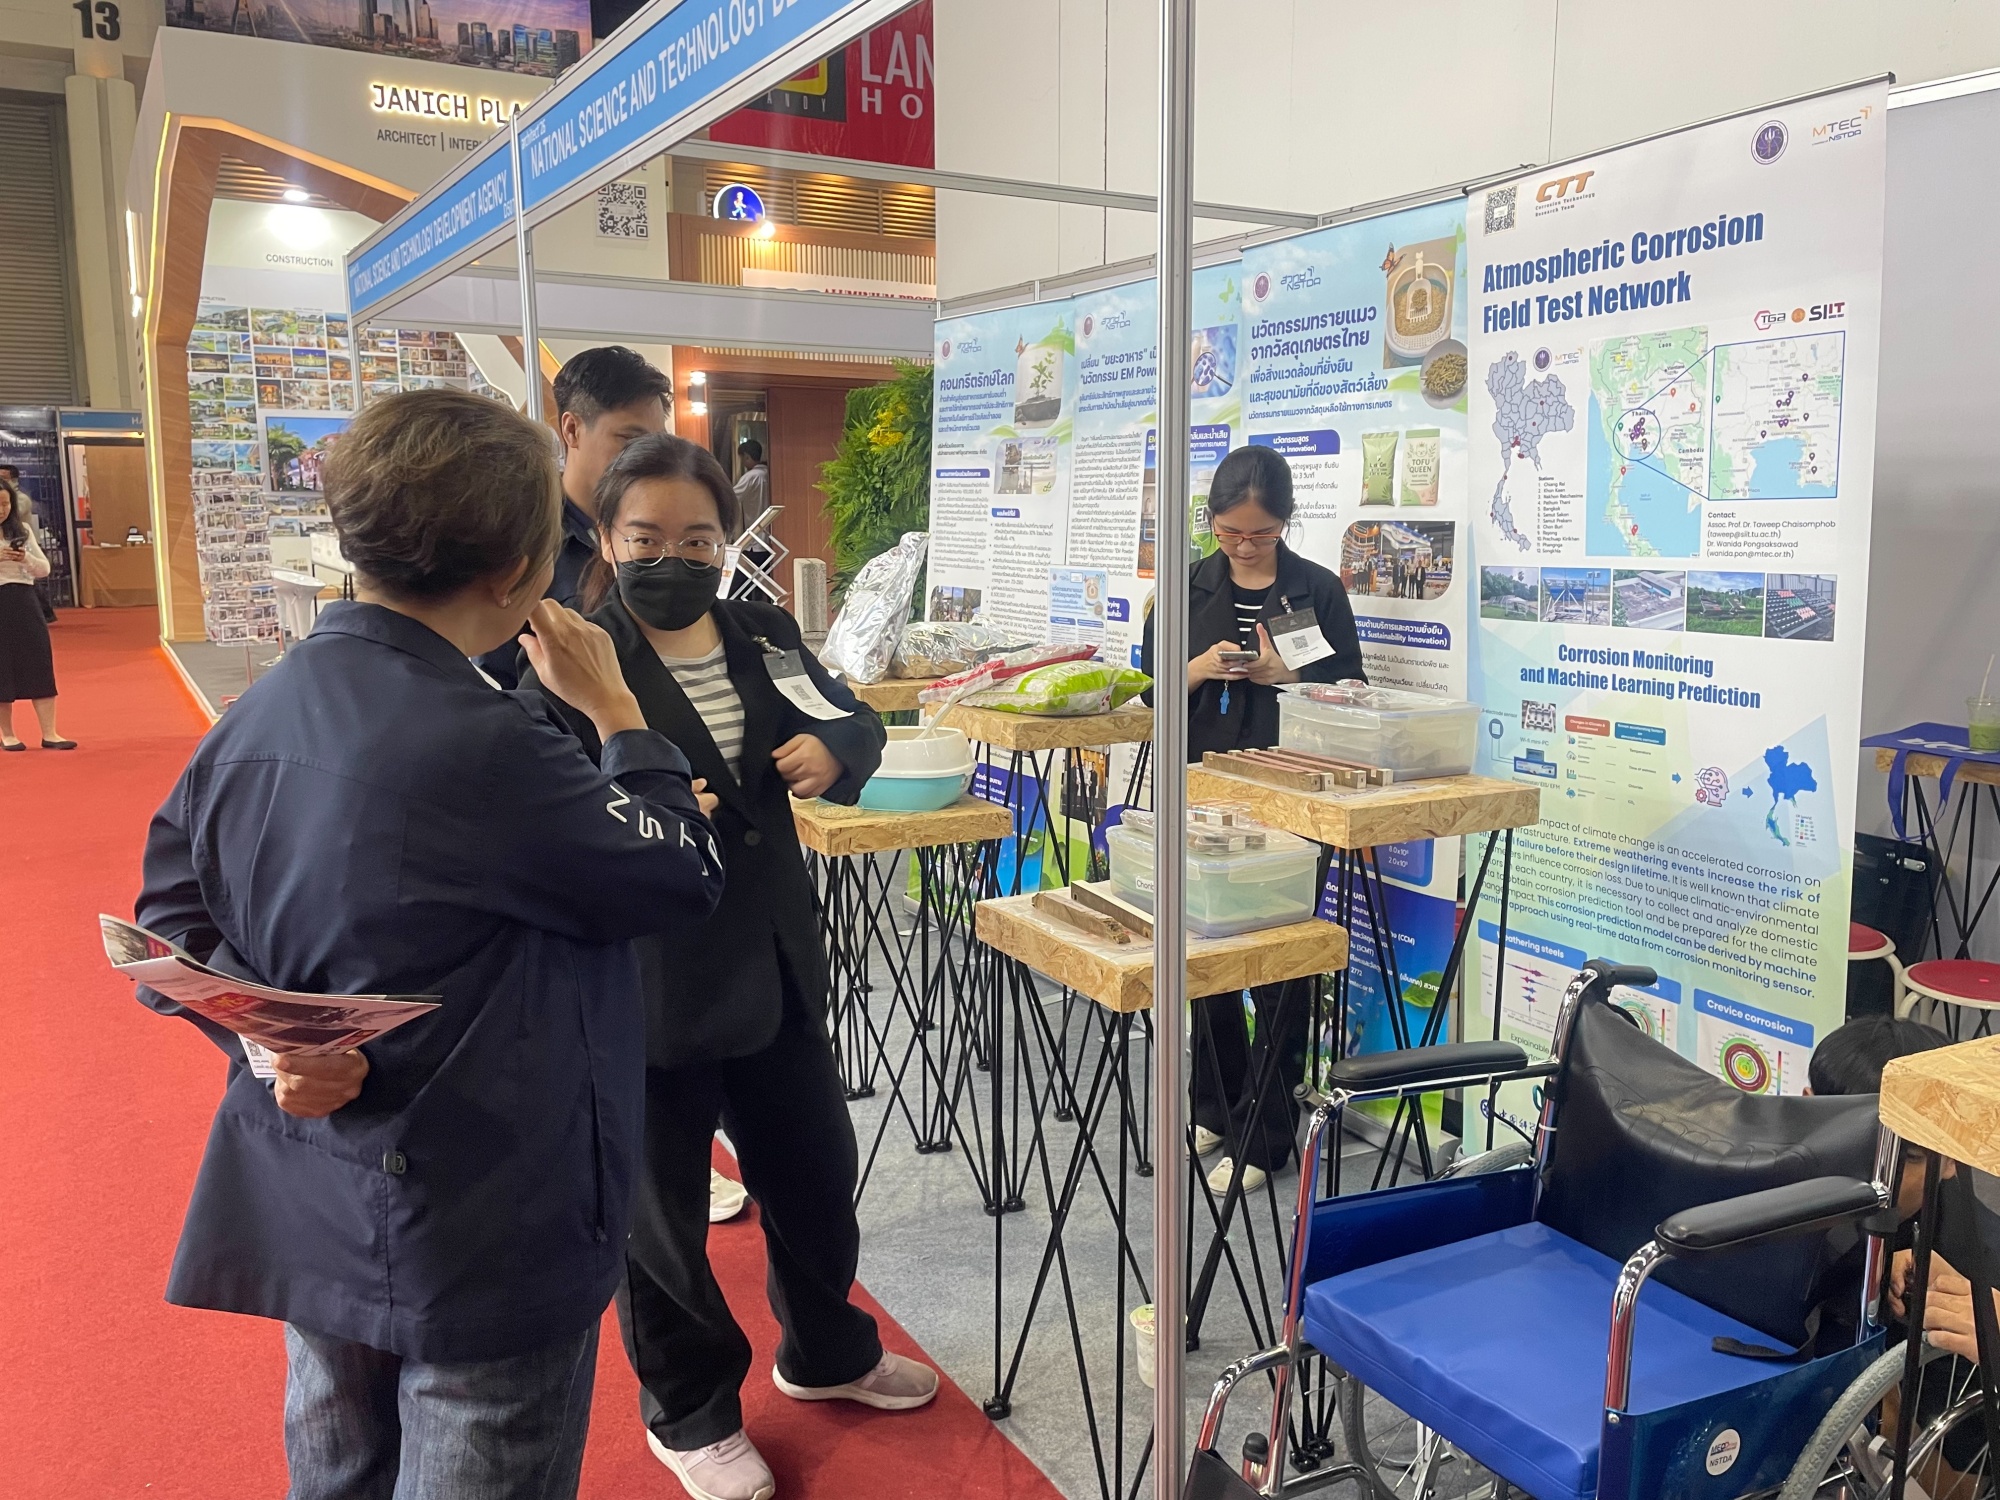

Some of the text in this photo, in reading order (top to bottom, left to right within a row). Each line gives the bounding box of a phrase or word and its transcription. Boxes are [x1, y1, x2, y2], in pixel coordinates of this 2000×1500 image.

[73, 0, 120, 41] 13
[373, 84, 468, 118] JANICH
[766, 92, 826, 112] ANDY
[862, 87, 924, 120] HO
[530, 119, 578, 180] NATIONAL
[578, 80, 628, 148] SCIENCE
[630, 60, 657, 116] AND
[1813, 116, 1862, 137] MTEC
[377, 129, 436, 147] ARCHITECT
[1536, 170, 1594, 203] CTT
[1560, 204, 1575, 212] Team
[372, 254, 391, 286] SCIENCE
[400, 220, 434, 267] TECHNOLOGY
[433, 191, 477, 246] DEVELOPMENT
[478, 169, 508, 219] AGENCY
[266, 254, 334, 267] CONSTRUCTION
[1483, 212, 1764, 293] Atmospheric Corrosion
[1484, 271, 1692, 334] Field Test Network
[1809, 302, 1845, 321] SIIT
[1252, 306, 1377, 339] นวัตกรรมทรายแมว
[1251, 328, 1370, 360] จากวัสดุเกษตรไทย
[940, 369, 1014, 391] คอนกรีตรักษ์โลก
[1120, 367, 1134, 380] EM
[1250, 356, 1353, 384] เพื่อสิ่งแวดล้อมที่ยั่งยืน
[1250, 372, 1388, 406] และสุขอนามัยที่ดีของสัตว์เลี้ยง
[1287, 444, 1316, 453] Innovation)
[1782, 521, 1836, 529] Chaisomphob
[1744, 541, 1798, 549] Pongsaksawad
[1355, 619, 1442, 634] รรมด้านบริการและความยั่งยืน
[1368, 630, 1406, 643] Sustainability
[1408, 636, 1448, 646] Innovation)
[1558, 644, 1714, 678] Corrosion Monitoring
[1520, 667, 1761, 708] and Machine Learning Prediction
[1540, 818, 1821, 888] mpact of climate change is an accelerated corrosion on
[1516, 838, 1820, 920] failure before their design lifetime. It is well known that climate
[1574, 838, 1820, 903] Extreme weathering events increase the risk of
[1516, 864, 1818, 951] each country, it is necessary to collect and analyze domestic
[1523, 853, 1818, 935] influence corrosion loss. Due to unique climatic-environmental
[1398, 934, 1415, 946] (CCM)
[1536, 882, 1576, 899] corrosion
[1578, 894, 1622, 912] prediction
[1626, 906, 1644, 918] tool
[1646, 912, 1664, 924] and
[1668, 916, 1680, 928] be
[1682, 924, 1730, 943] prepared
[1732, 935, 1746, 948] for
[1750, 941, 1768, 954] the
[1771, 948, 1817, 966] climate
[1538, 894, 1816, 982] This corrosion prediction model can be derived by machine
[1509, 902, 1815, 998] approach using real-time data from corrosion monitoring sensor.
[1541, 946, 1564, 958] steels
[1351, 966, 1362, 976] 2772
[1707, 1000, 1794, 1034] Crevice corrosion
[1510, 1033, 1550, 1054] Explainable
[1710, 1454, 1732, 1467] NSTDA
